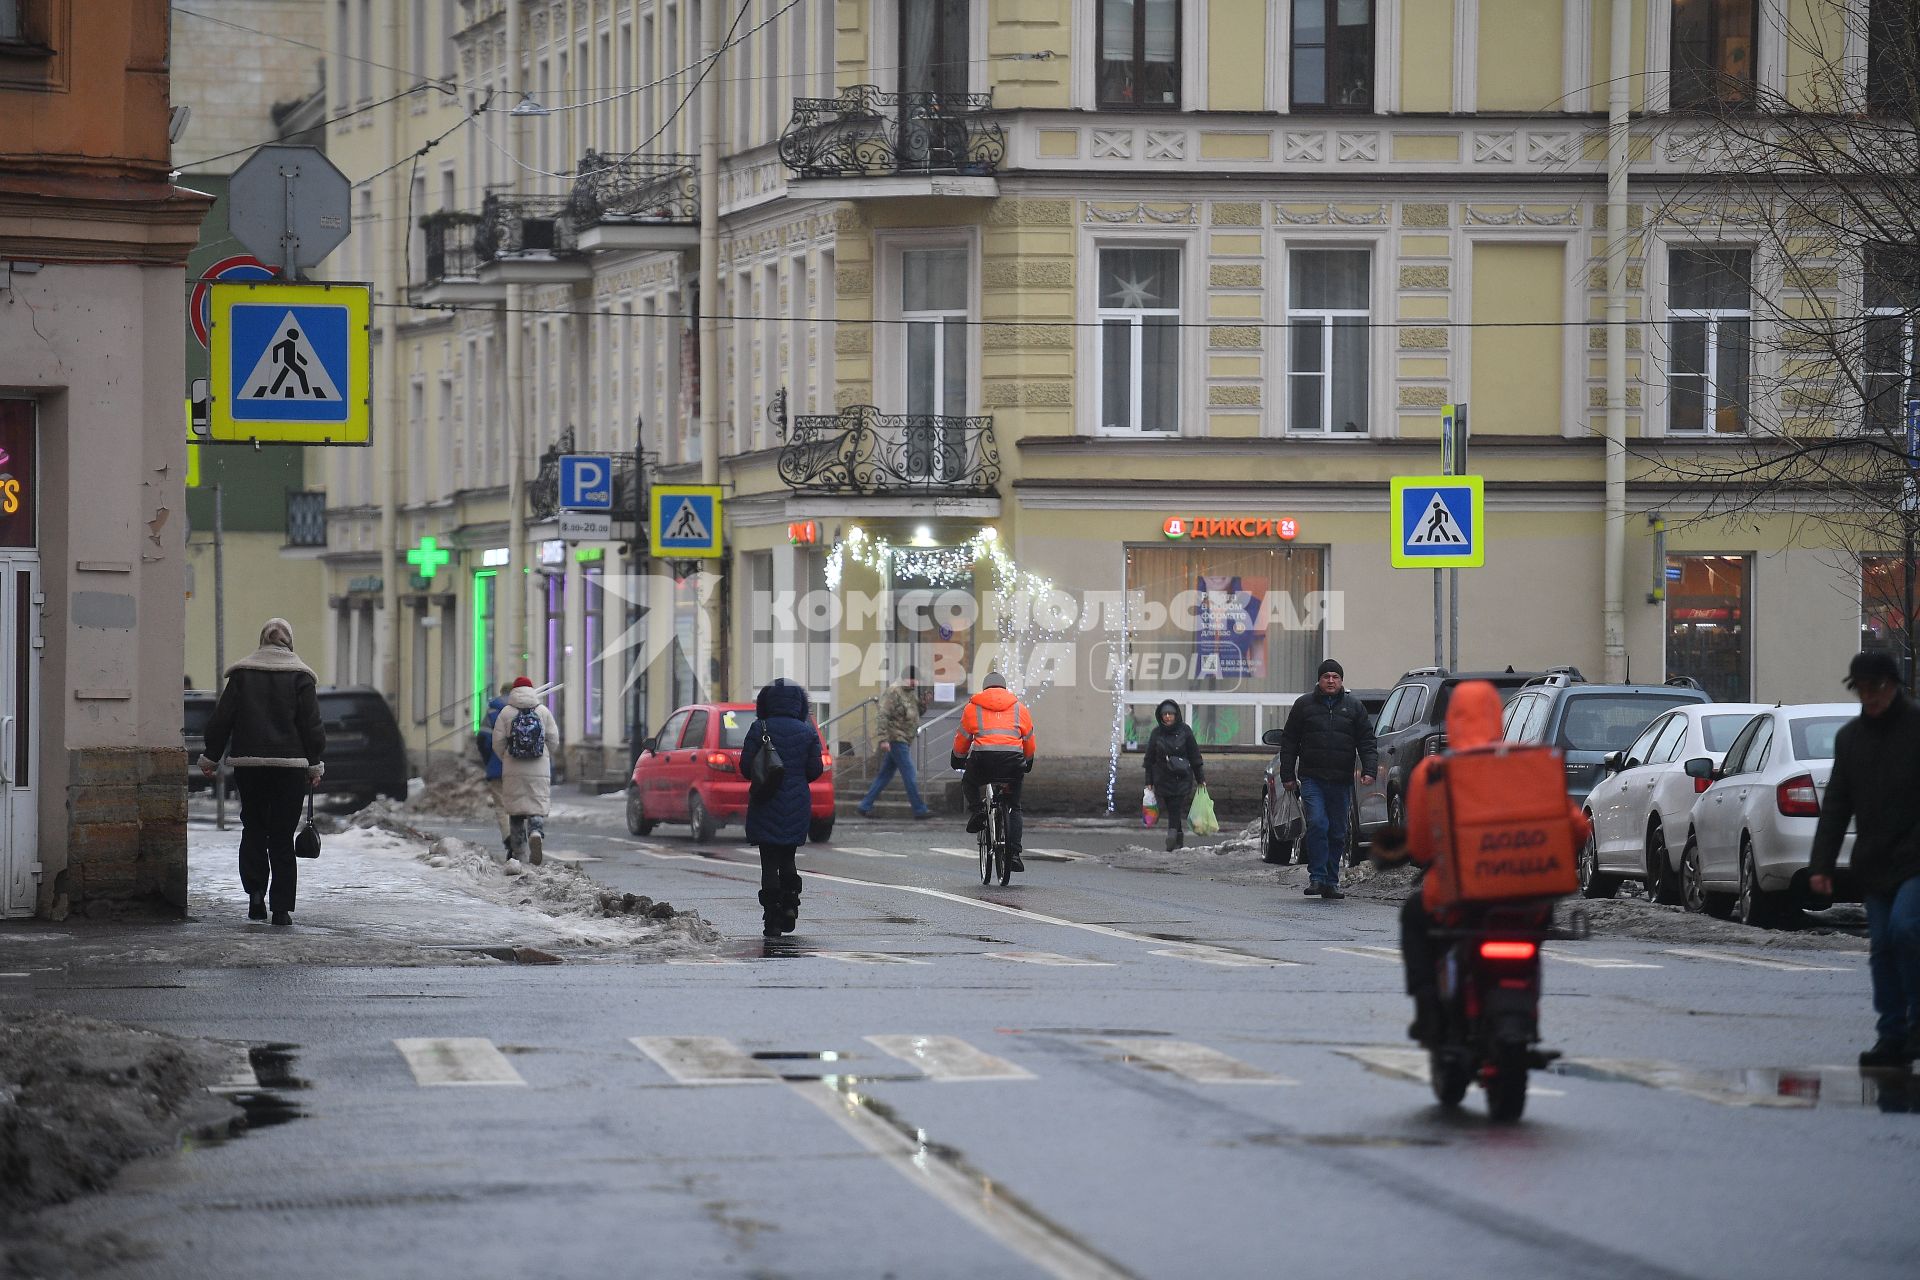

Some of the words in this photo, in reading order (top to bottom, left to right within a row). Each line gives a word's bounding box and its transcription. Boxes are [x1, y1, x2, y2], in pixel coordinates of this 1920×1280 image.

[1191, 517, 1272, 538] ДИКСИ
[1281, 520, 1295, 530] 24
[1475, 856, 1560, 877] ПИЦЦА
